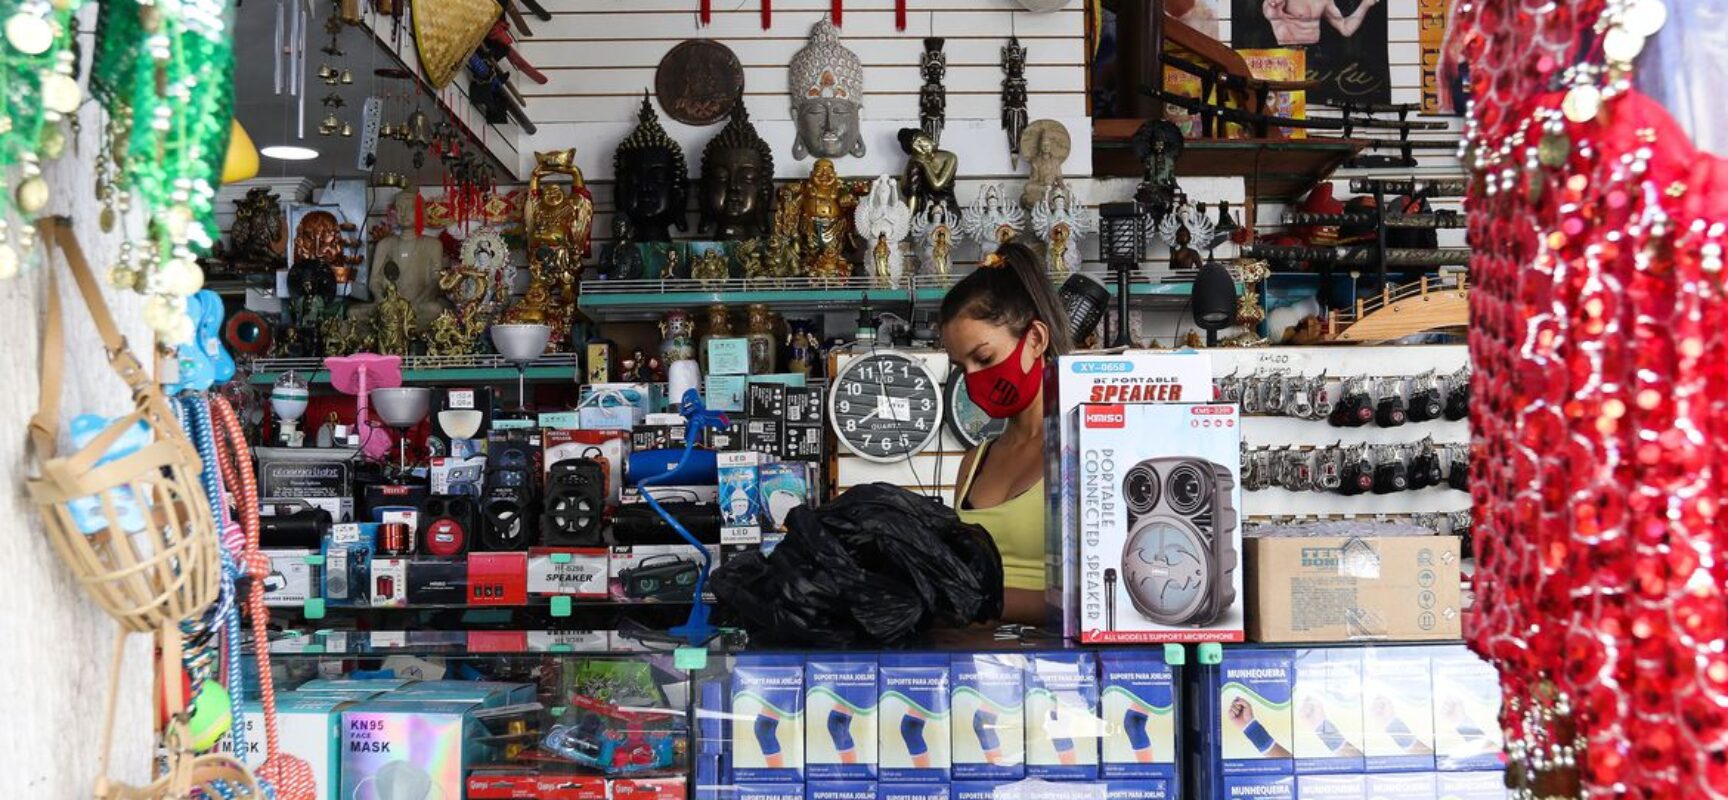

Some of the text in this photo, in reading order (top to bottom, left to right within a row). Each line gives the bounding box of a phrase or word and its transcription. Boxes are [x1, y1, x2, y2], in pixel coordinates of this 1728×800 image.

[858, 366, 873, 380] 11
[877, 360, 893, 374] 12
[900, 366, 909, 378] 1
[1080, 362, 1126, 372] XY-0658
[914, 377, 925, 391] 2
[1111, 376, 1179, 384] PORTABLE
[844, 383, 862, 396] 10
[1089, 384, 1183, 402] SPEAKER
[839, 400, 850, 413] 9
[920, 398, 931, 411] 3
[846, 419, 856, 432] 8
[914, 417, 925, 430] 4
[861, 434, 872, 447] 7
[881, 437, 892, 450] 6
[899, 433, 909, 447] 5
[1101, 449, 1115, 527] PORTABLE
[1085, 449, 1100, 620] CONNECTED SPEAKER
[545, 573, 593, 583] SPEAKER
[1227, 669, 1286, 678] MUNHEQUEIRA
[350, 720, 384, 730] KN95
[350, 742, 390, 753] MASK
[1231, 785, 1290, 795] MUNHEQUEIRA
